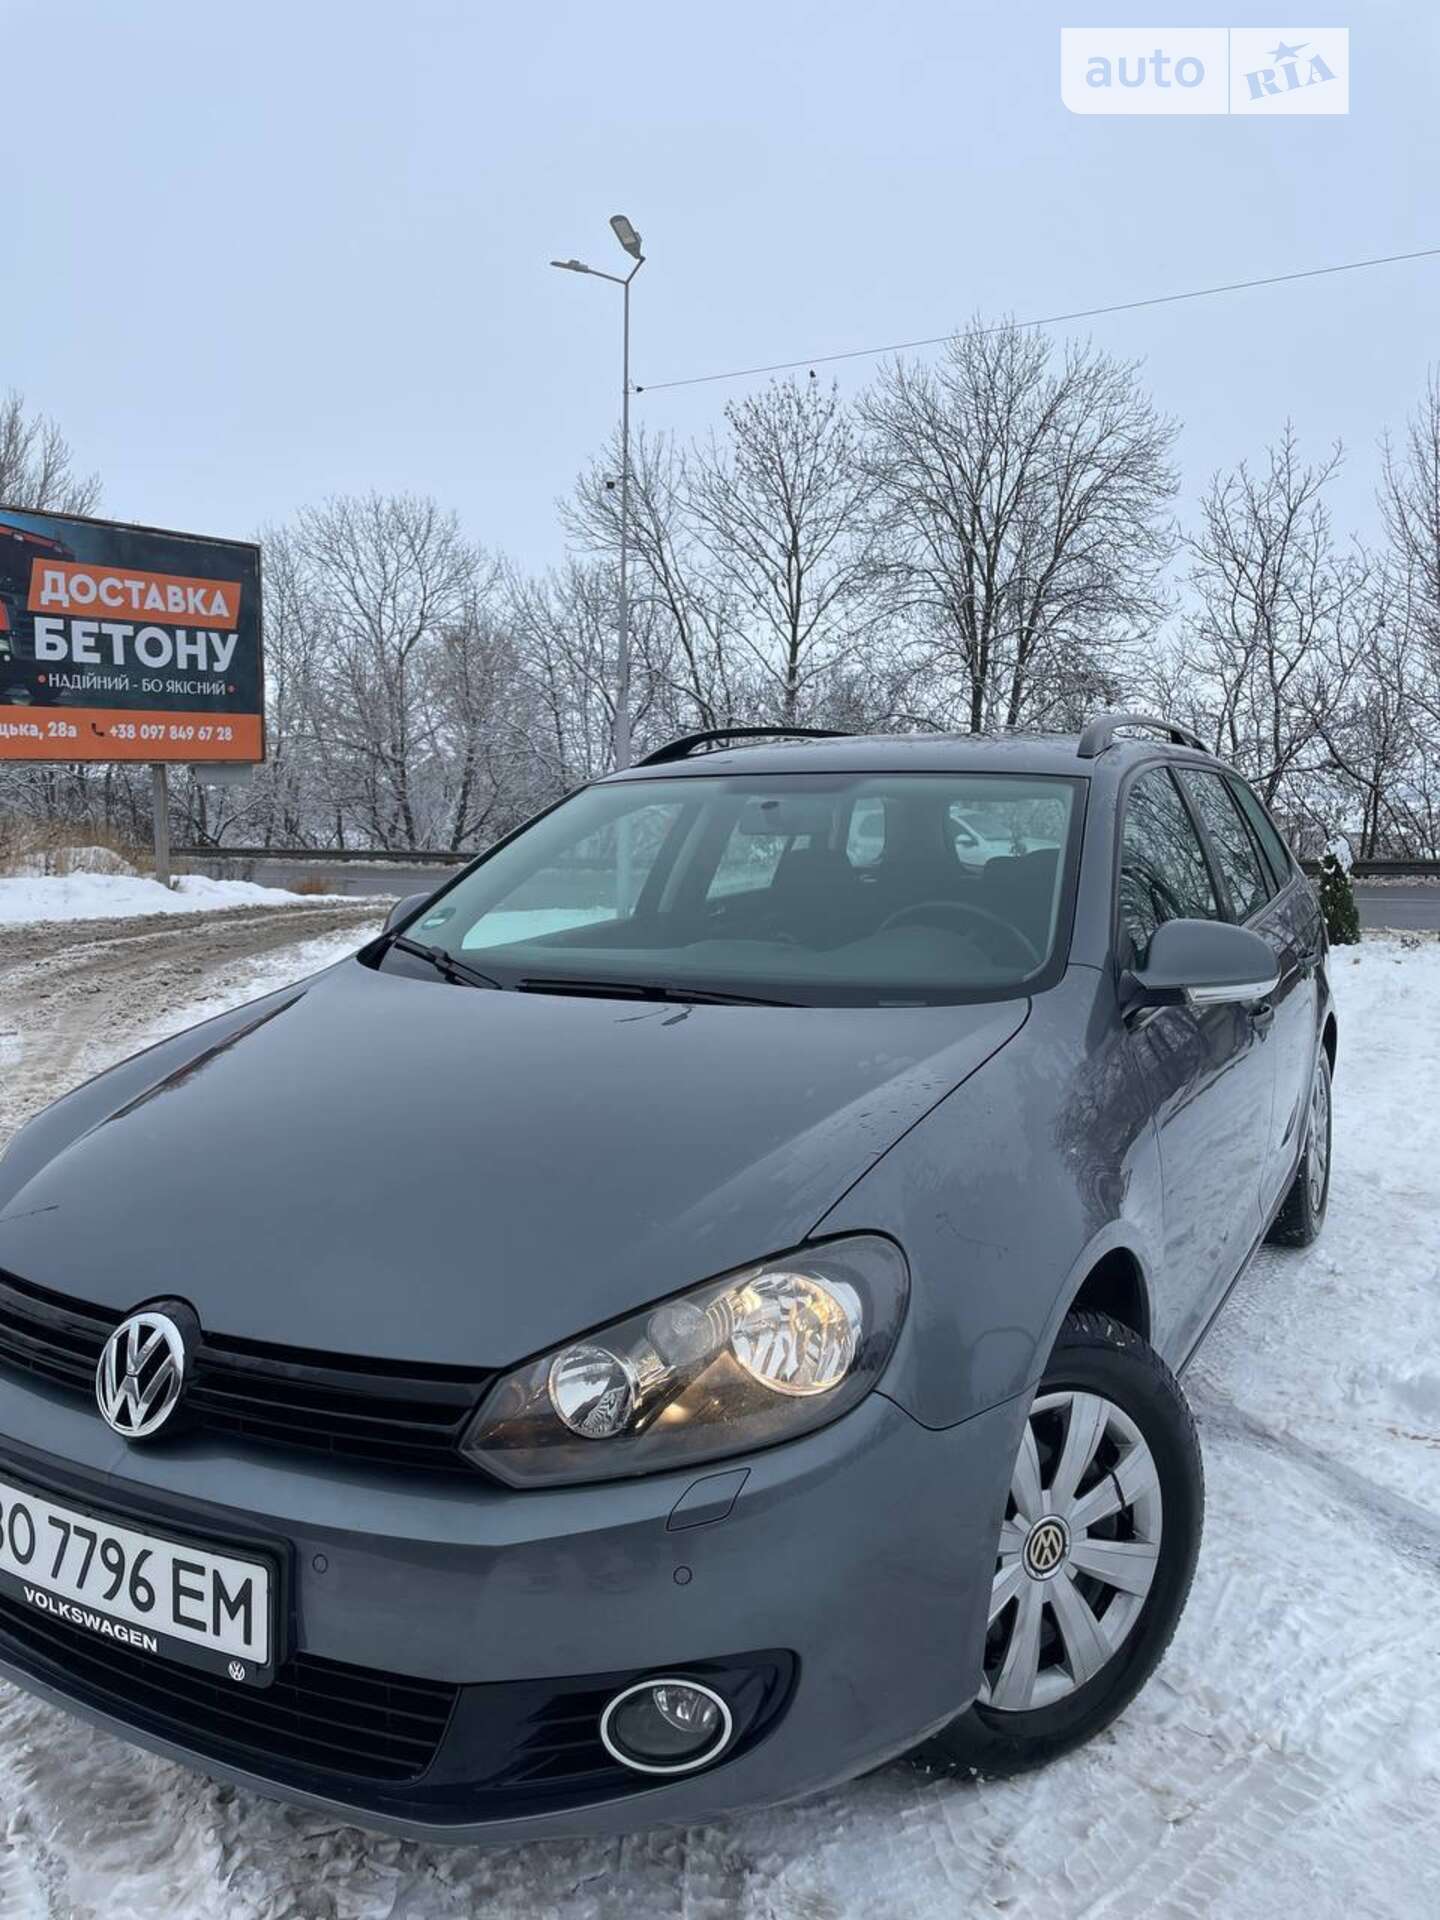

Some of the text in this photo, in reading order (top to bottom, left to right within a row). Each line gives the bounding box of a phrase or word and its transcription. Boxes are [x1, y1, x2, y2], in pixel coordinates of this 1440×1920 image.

[40, 570, 229, 617] ДОСТАВКА
[34, 616, 239, 672] БЕТОНУ
[49, 672, 129, 691] НАДІЙНИЙ
[142, 679, 162, 693] БО
[166, 680, 226, 696] ЯКІСНИЙ
[47, 721, 77, 737] 28а
[110, 724, 233, 741] +38 097 849 67 28
[0, 1500, 252, 1646] O 7796 EM
[23, 1585, 158, 1652] VOLKSWAGEN
